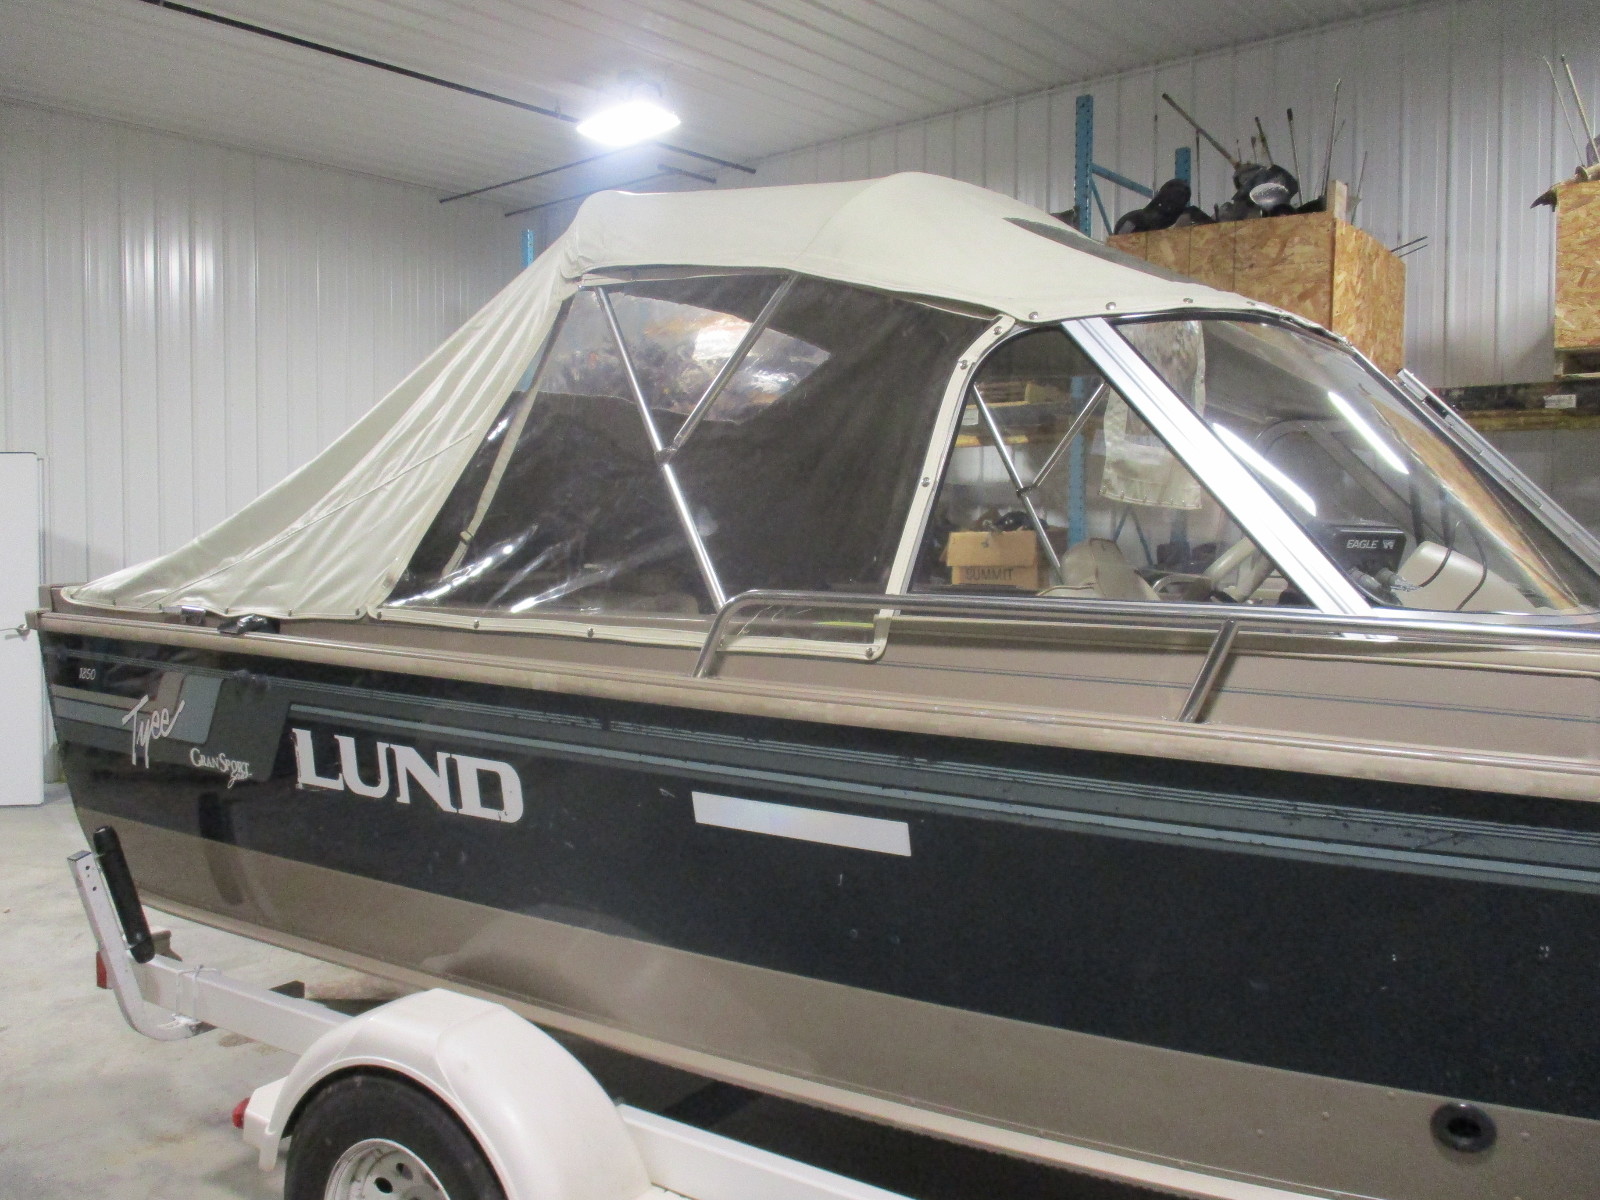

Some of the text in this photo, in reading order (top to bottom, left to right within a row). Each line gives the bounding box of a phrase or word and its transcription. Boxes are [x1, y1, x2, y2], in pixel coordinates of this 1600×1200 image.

[1346, 540, 1379, 549] EAGLE
[965, 567, 1014, 581] SUMMIT
[79, 667, 96, 680] 1850
[121, 694, 185, 769] Tyee
[292, 727, 524, 824] LUND
